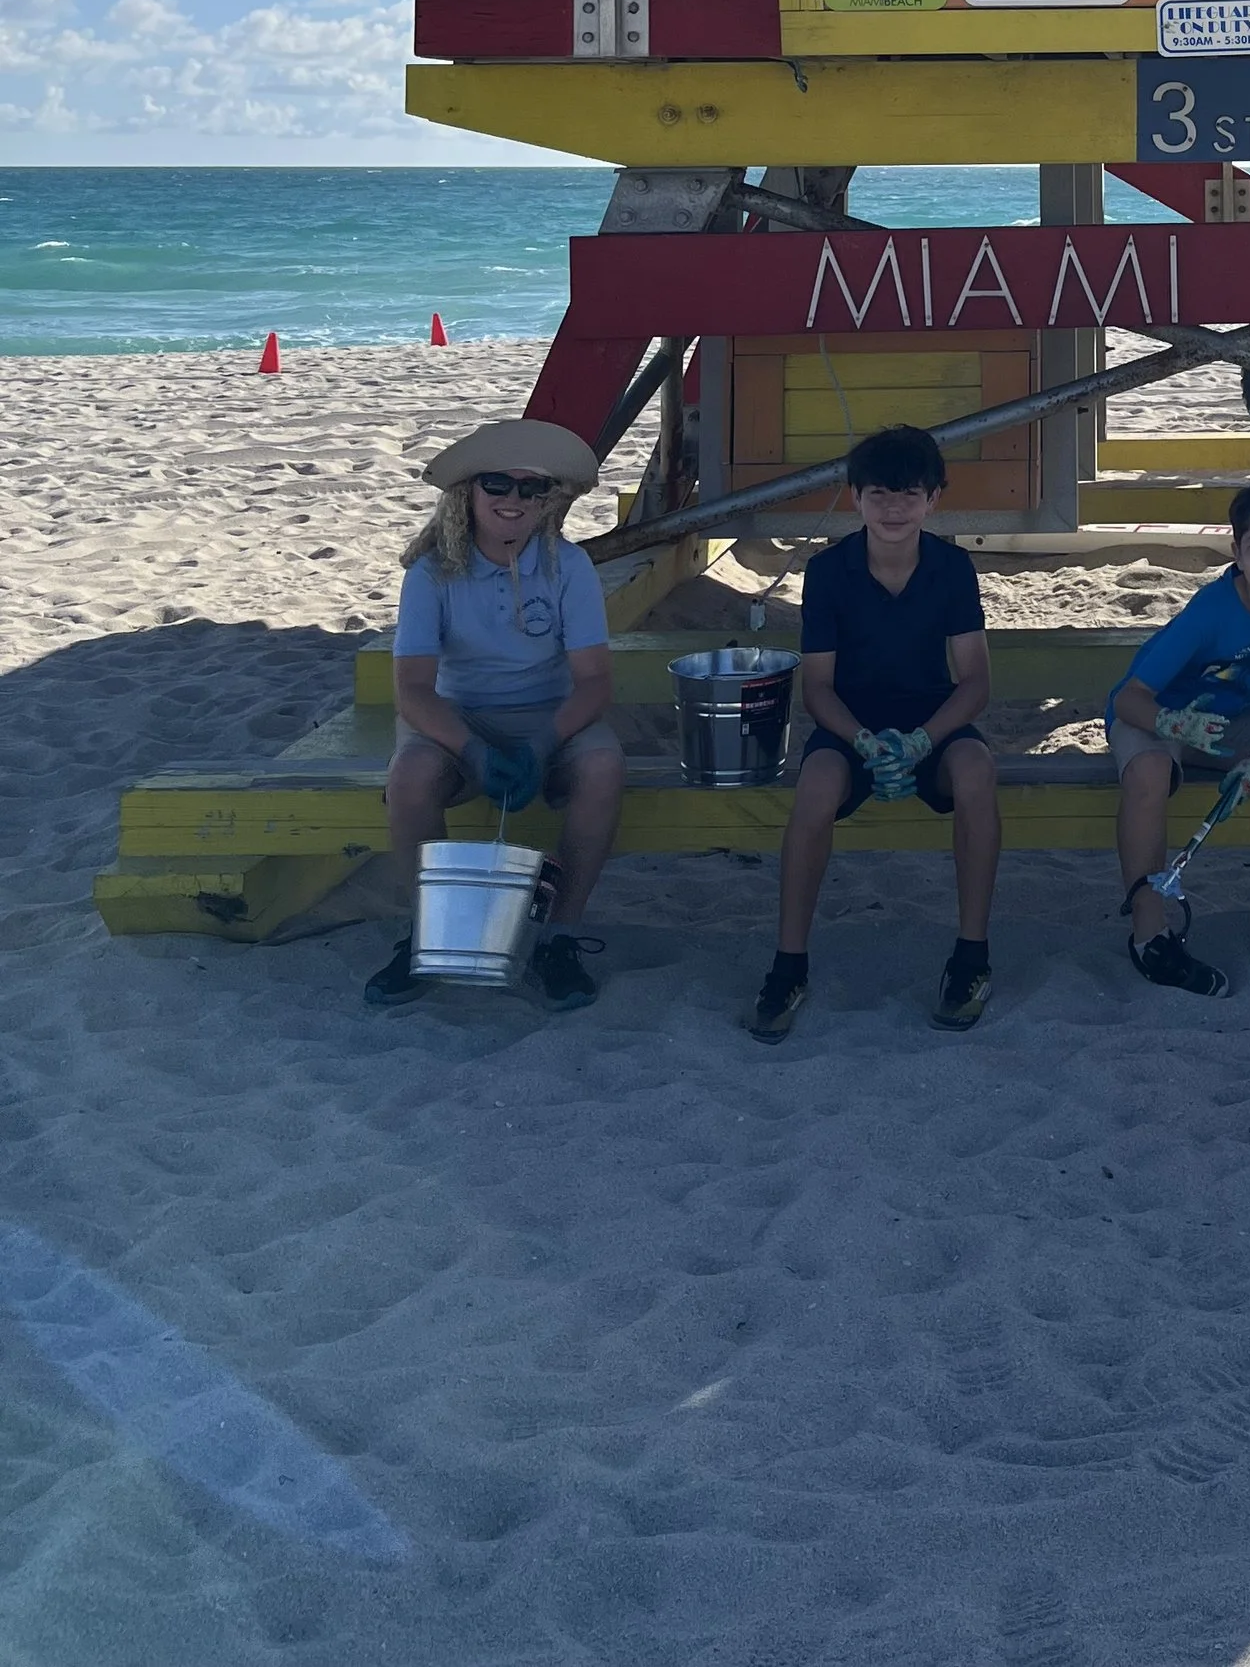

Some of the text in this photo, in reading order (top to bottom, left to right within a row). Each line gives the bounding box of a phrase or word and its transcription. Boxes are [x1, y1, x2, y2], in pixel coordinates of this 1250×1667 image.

[1173, 37, 1213, 46] 9:30AM
[1180, 22, 1204, 34] ON
[1152, 82, 1196, 154] 3
[806, 234, 1178, 329] MIAMI
